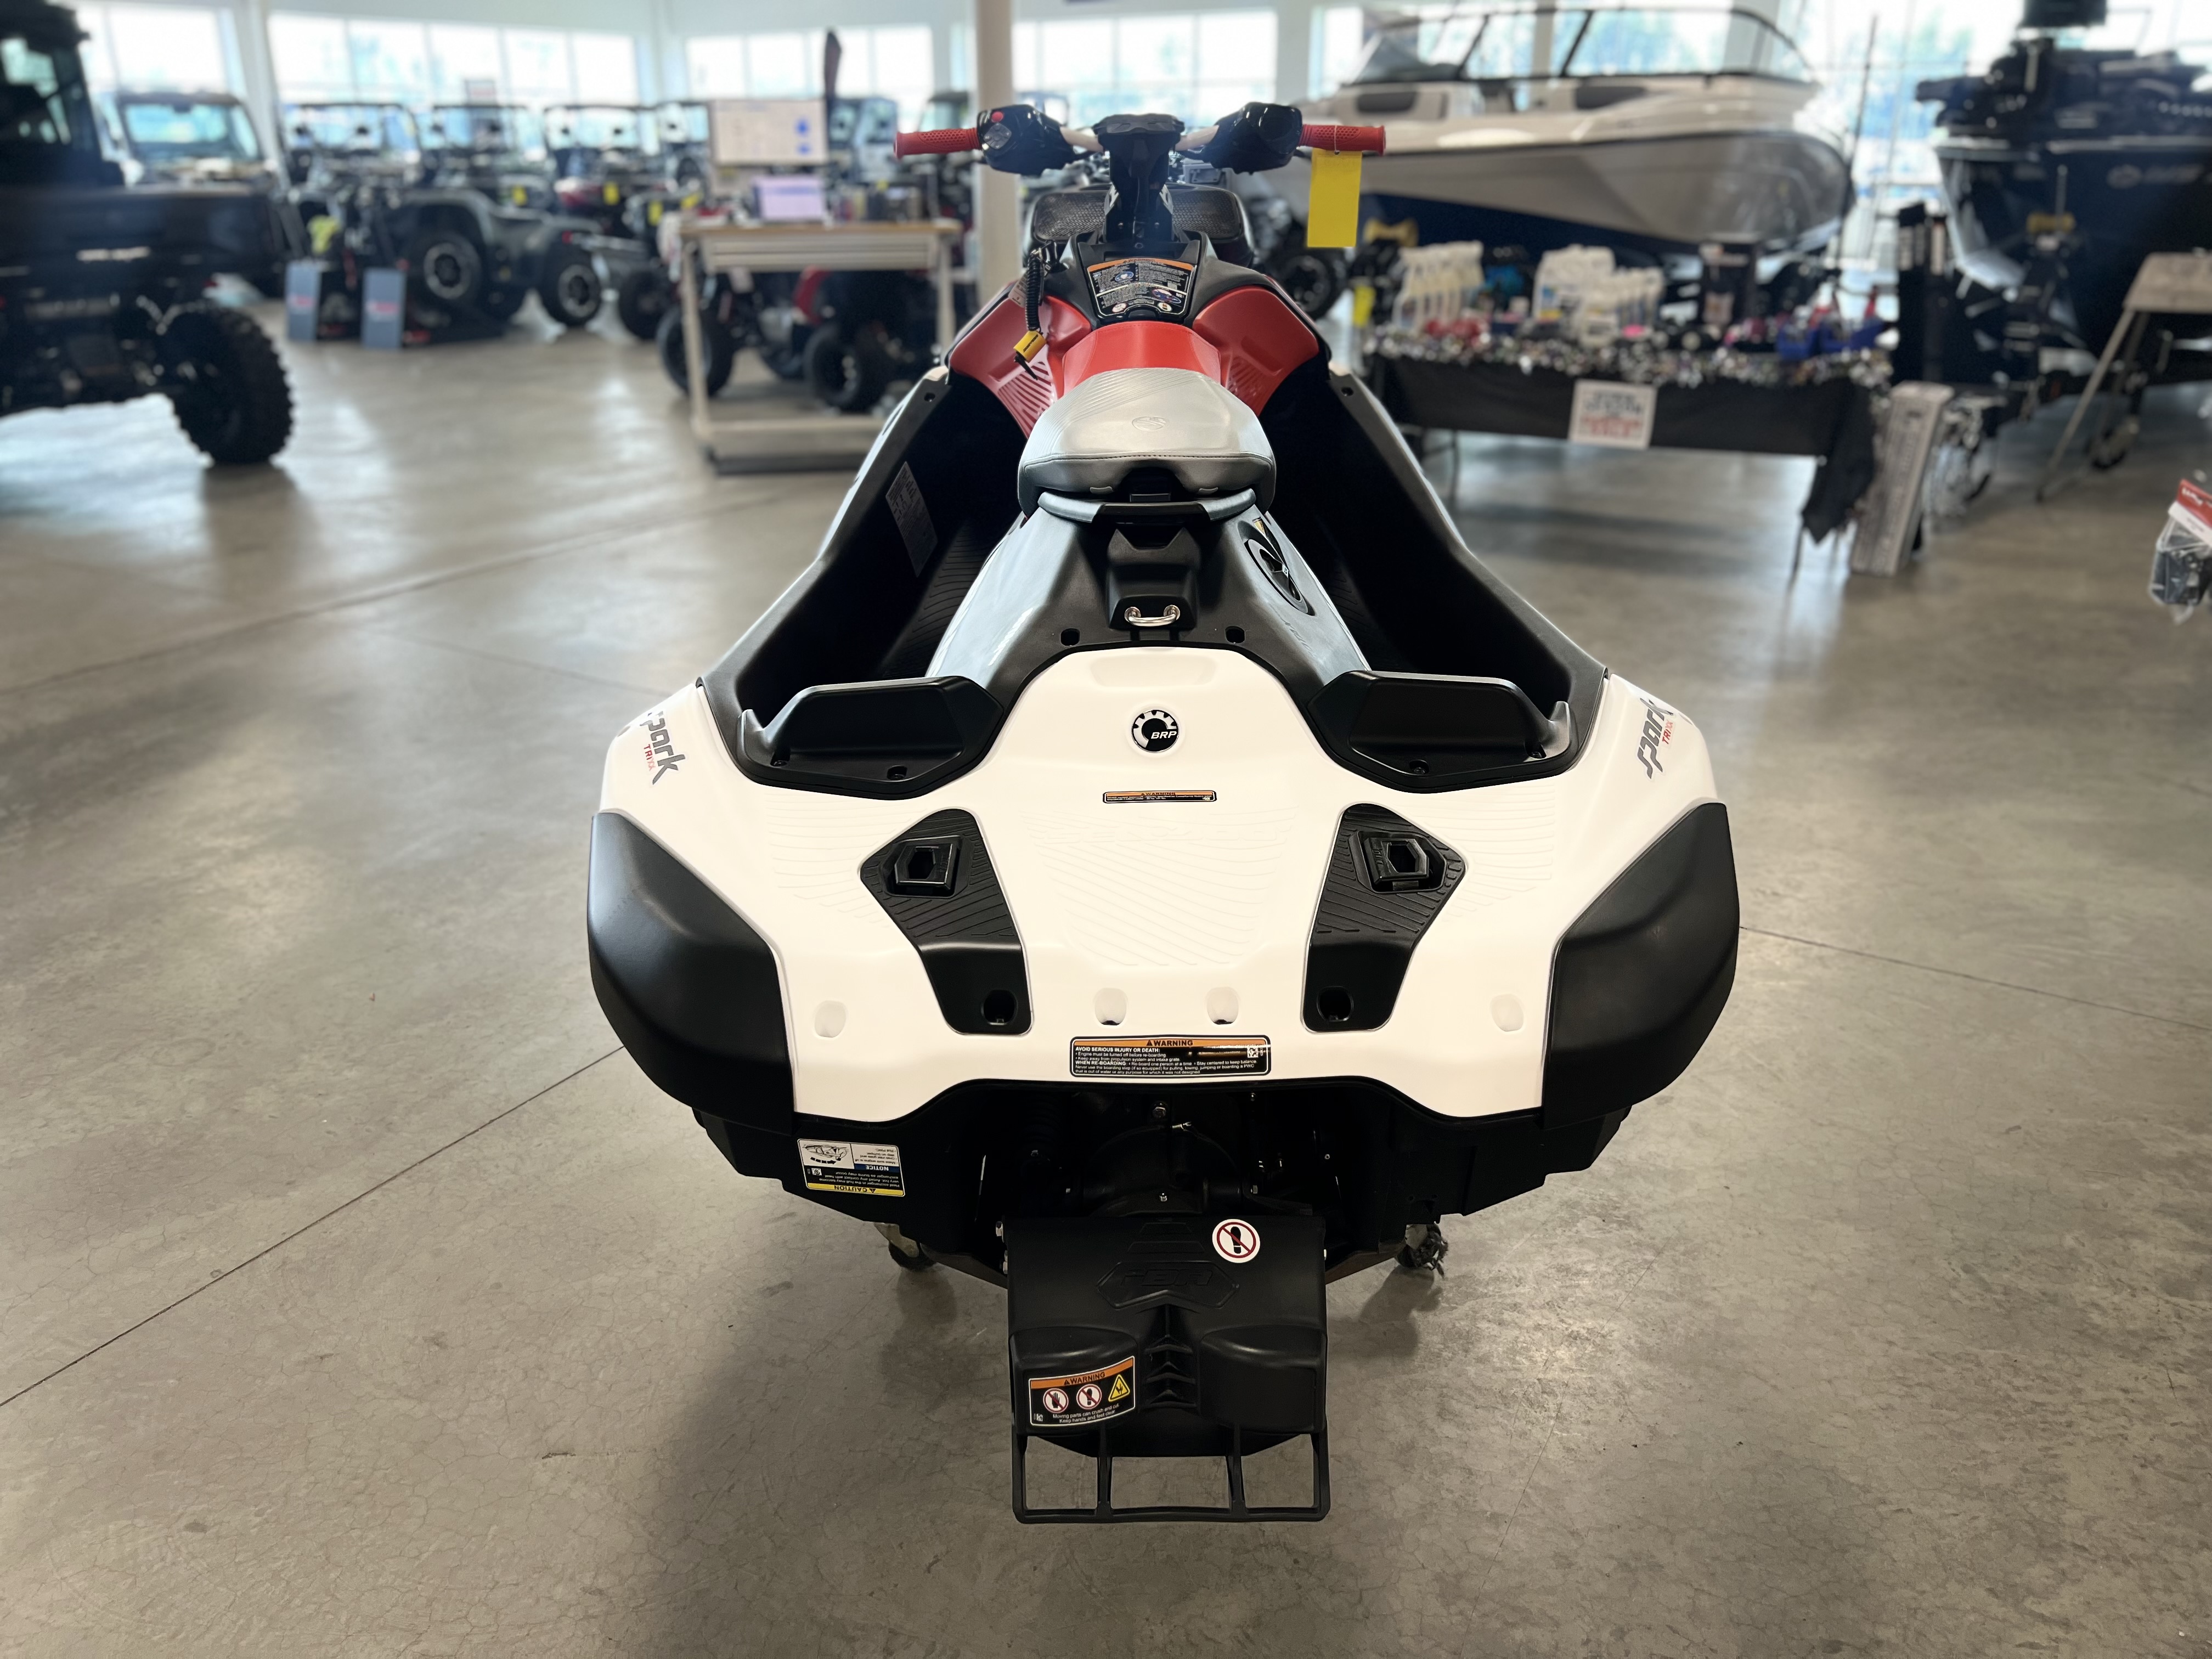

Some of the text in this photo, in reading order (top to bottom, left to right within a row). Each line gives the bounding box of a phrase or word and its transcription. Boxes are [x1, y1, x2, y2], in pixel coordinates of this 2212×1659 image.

[1151, 731, 1177, 739] BRP
[1637, 698, 1673, 779] spark
[1662, 719, 1674, 744] TRIXX
[1070, 1372, 1105, 1384] WARNING
